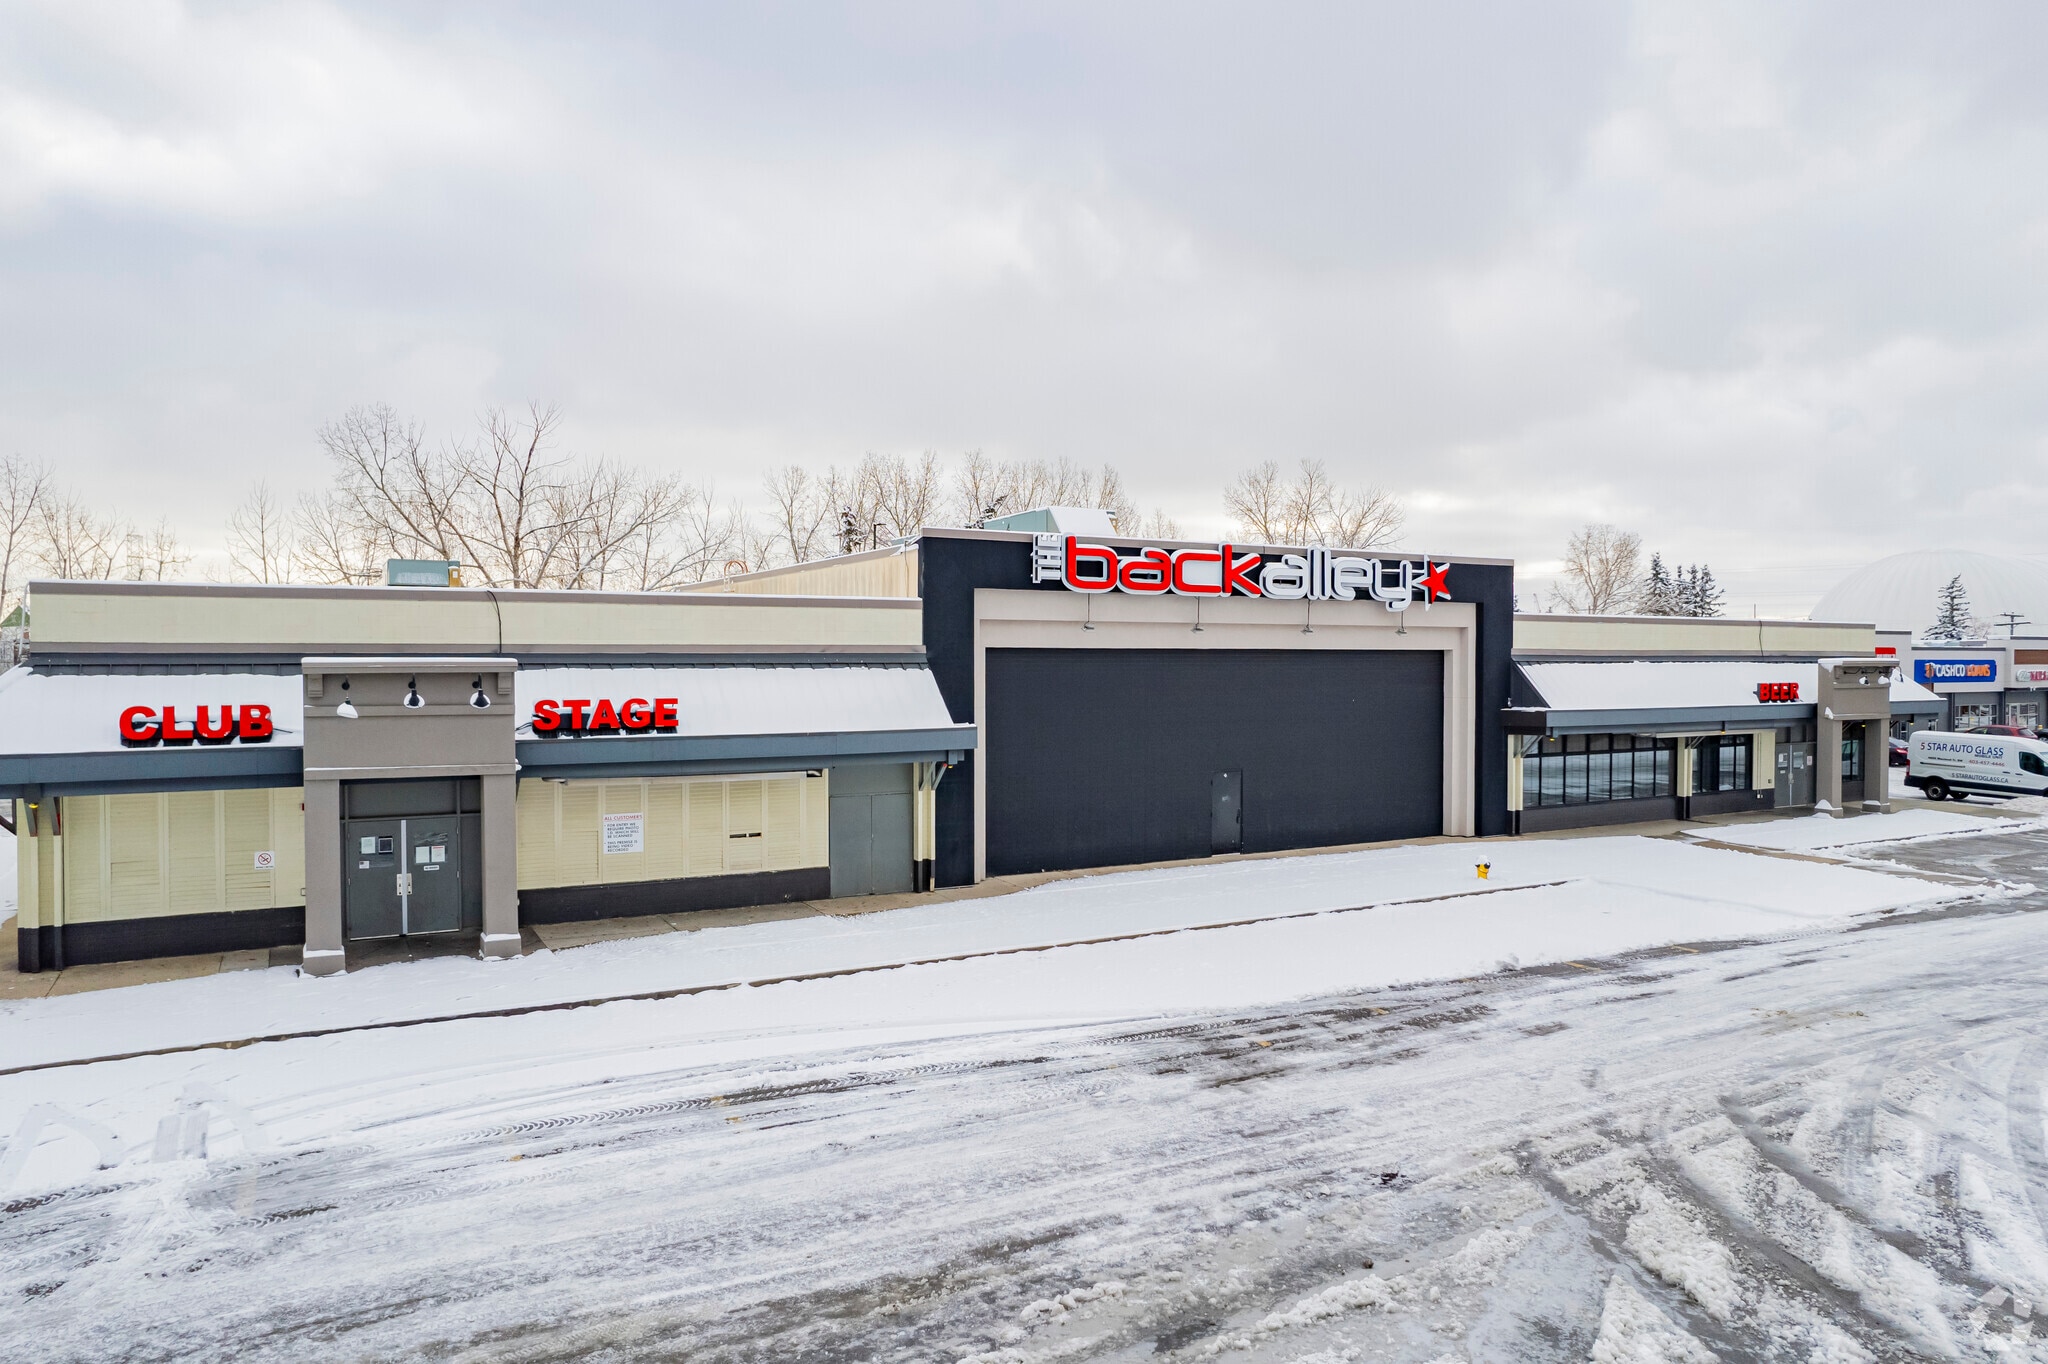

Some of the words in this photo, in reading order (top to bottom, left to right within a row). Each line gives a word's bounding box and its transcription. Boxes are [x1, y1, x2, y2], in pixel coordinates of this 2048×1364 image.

[1031, 533, 1062, 584] THE
[1936, 664, 1965, 677] CASHCO
[1759, 682, 1799, 701] BEER
[119, 704, 273, 742] CLUB
[532, 697, 680, 732] STAGE
[1920, 742, 1925, 750] 5
[1927, 742, 1947, 751] STAR
[1949, 743, 1973, 753] AUTO
[1975, 746, 2004, 756] GLASS
